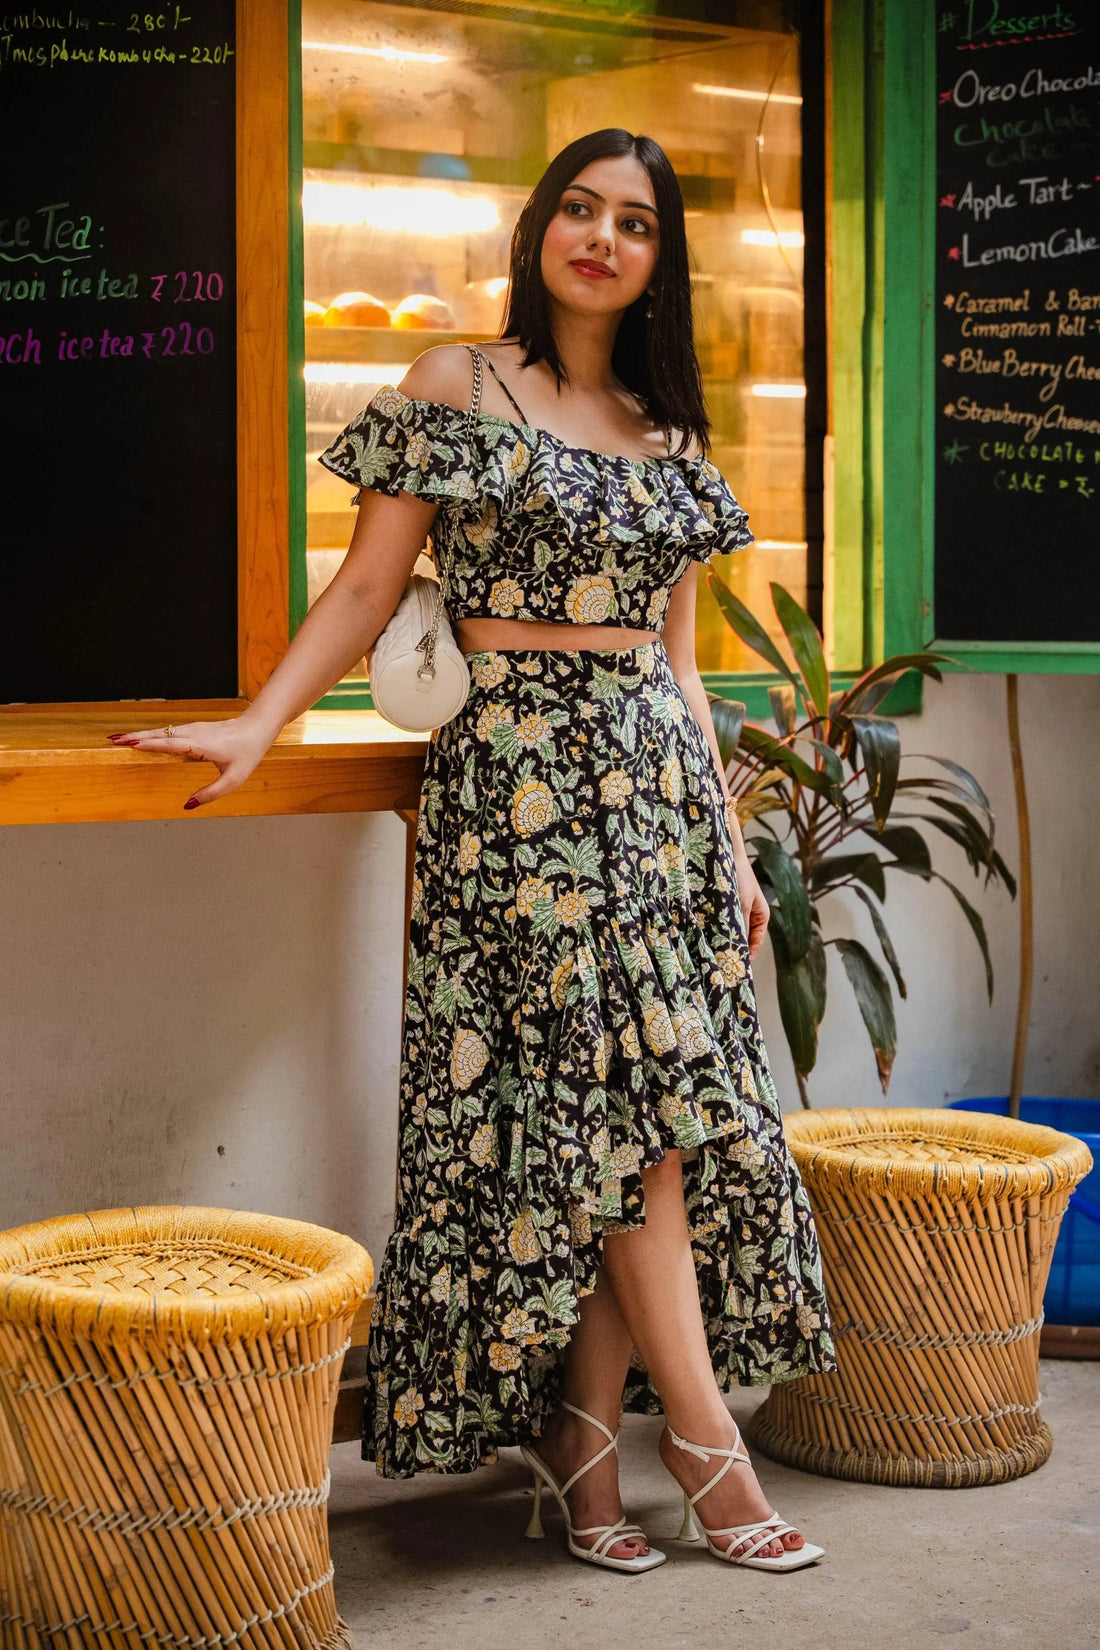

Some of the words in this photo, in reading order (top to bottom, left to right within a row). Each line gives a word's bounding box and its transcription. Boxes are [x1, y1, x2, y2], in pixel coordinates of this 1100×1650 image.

[959, 0, 1077, 40] Desserts
[957, 180, 1018, 222] Apple
[1018, 176, 1074, 205] Tart
[60, 268, 92, 299] ice
[96, 268, 139, 302] tea
[955, 288, 1031, 314] Caramel
[1045, 289, 1060, 311] &
[961, 317, 1051, 339] Cinnamon
[1057, 313, 1087, 338] Roll
[993, 469, 1047, 494] CAKE
